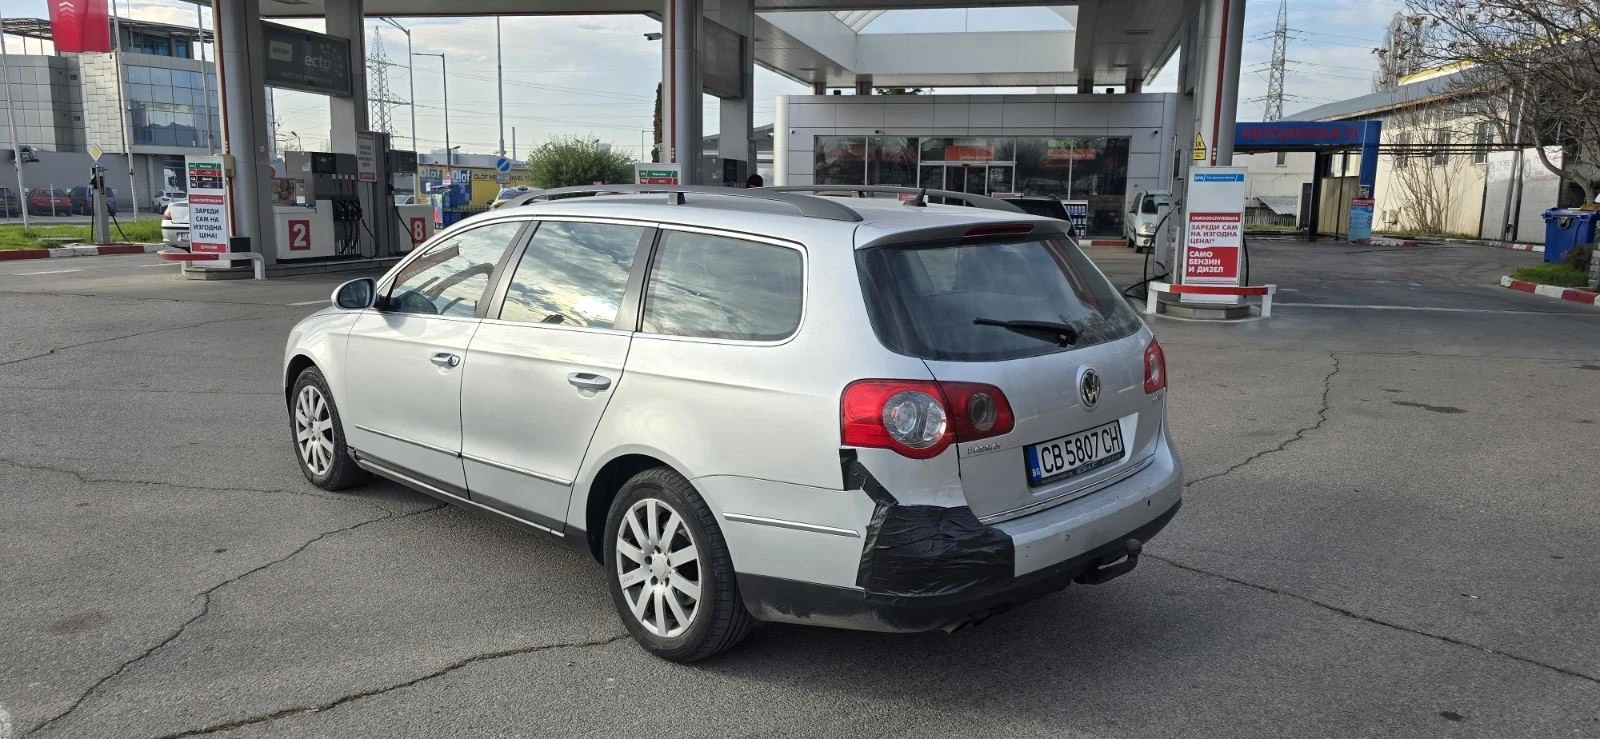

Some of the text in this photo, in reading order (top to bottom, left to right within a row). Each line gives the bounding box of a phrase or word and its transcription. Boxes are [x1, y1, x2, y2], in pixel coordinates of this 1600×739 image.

[304, 55, 331, 69] ecto
[293, 223, 307, 247] 2
[413, 220, 424, 241] 8
[1196, 266, 1224, 274] ДИЗЕЛ
[1041, 444, 1065, 474] CB
[1064, 432, 1099, 466] 5807
[1101, 426, 1121, 454] CH
